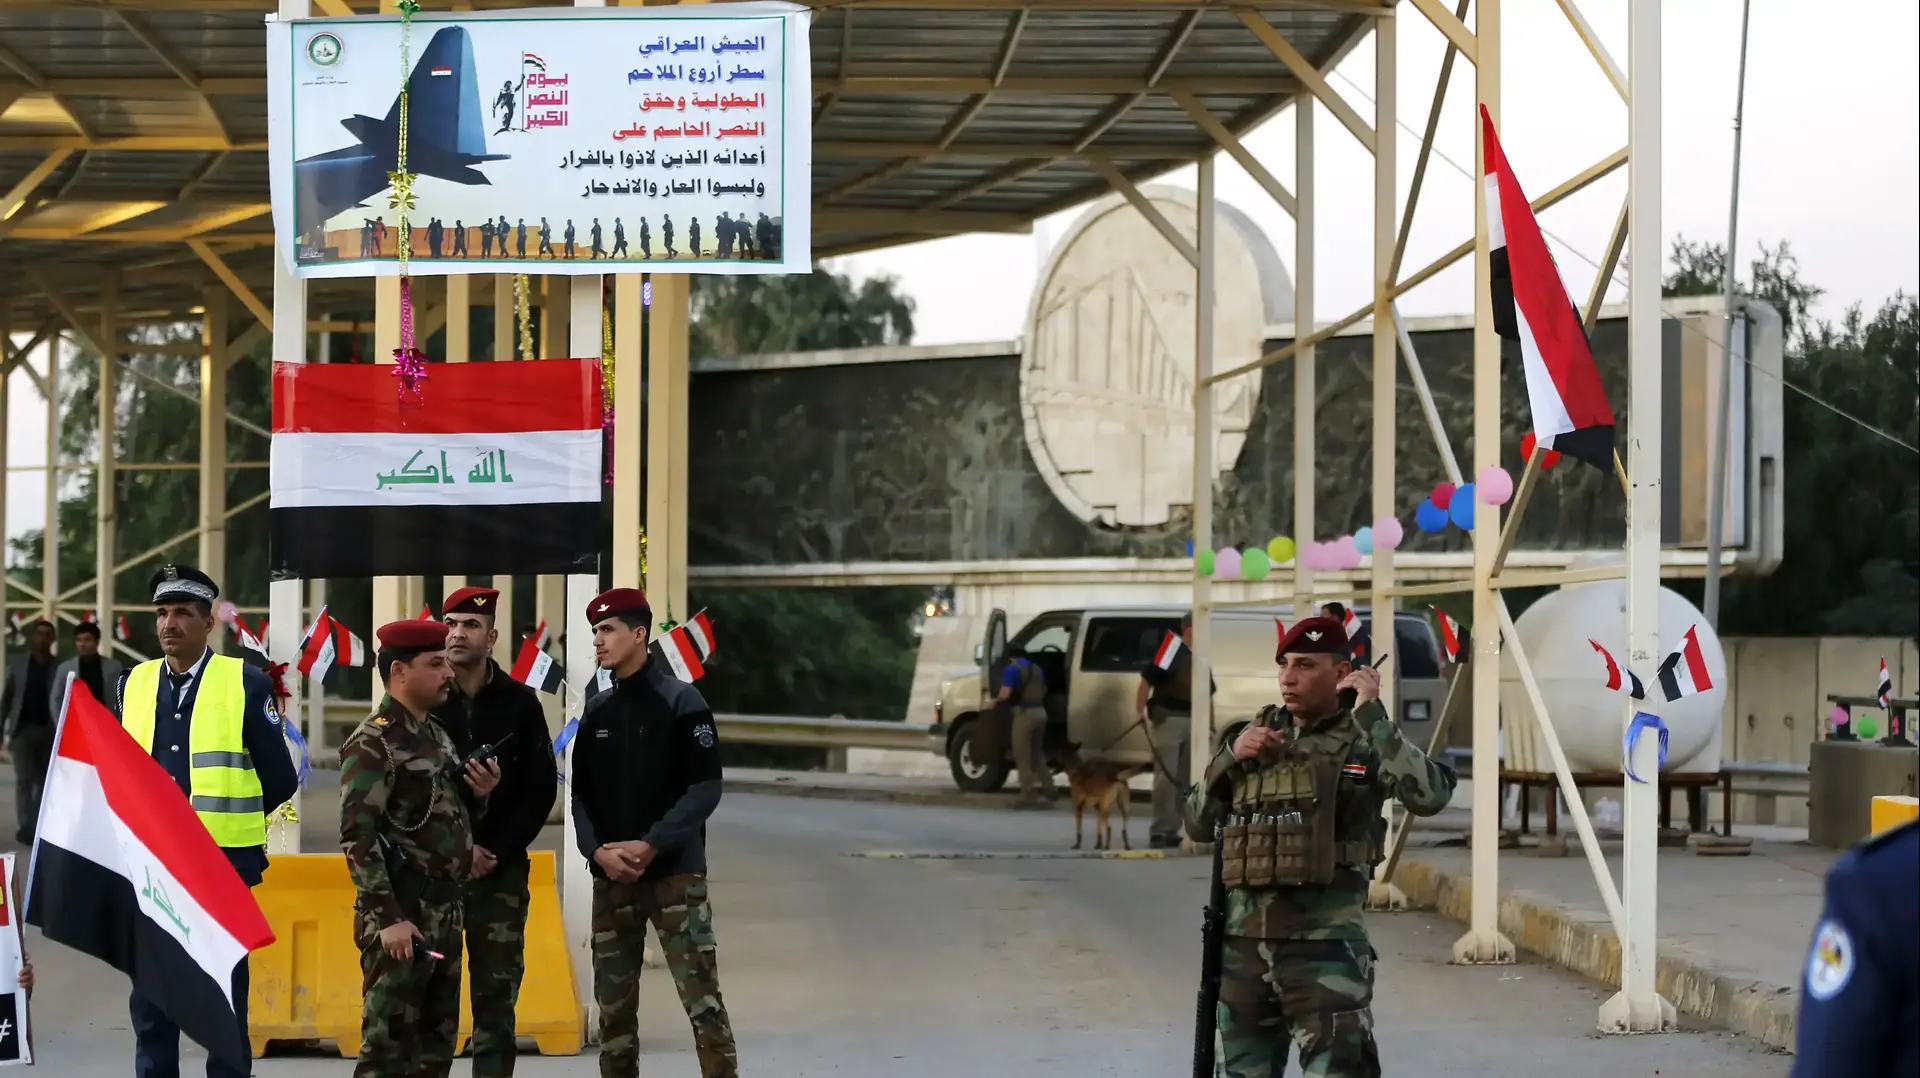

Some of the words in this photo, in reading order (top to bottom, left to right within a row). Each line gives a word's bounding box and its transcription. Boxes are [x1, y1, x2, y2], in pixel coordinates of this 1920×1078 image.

[638, 36, 705, 58] العراقي
[712, 35, 765, 54] الجيش
[627, 64, 683, 84] الملاحم
[689, 59, 721, 82] أروع
[726, 64, 765, 82] سطر
[526, 73, 568, 88] يوم
[526, 90, 568, 109] النصر
[638, 92, 686, 112] وحقق
[691, 92, 765, 112] البطولية
[525, 111, 568, 130] الكبير
[612, 121, 647, 141] على
[653, 121, 710, 141] الحاسم
[714, 121, 765, 140] النصر
[559, 149, 613, 168] بالفرار
[620, 149, 655, 168] لاذوا
[661, 149, 707, 168] الذين
[713, 145, 765, 165] أعدائه
[581, 178, 657, 197] والاندحار
[661, 178, 701, 197] العار
[707, 178, 765, 197] ولبسوا
[468, 447, 514, 483] الله
